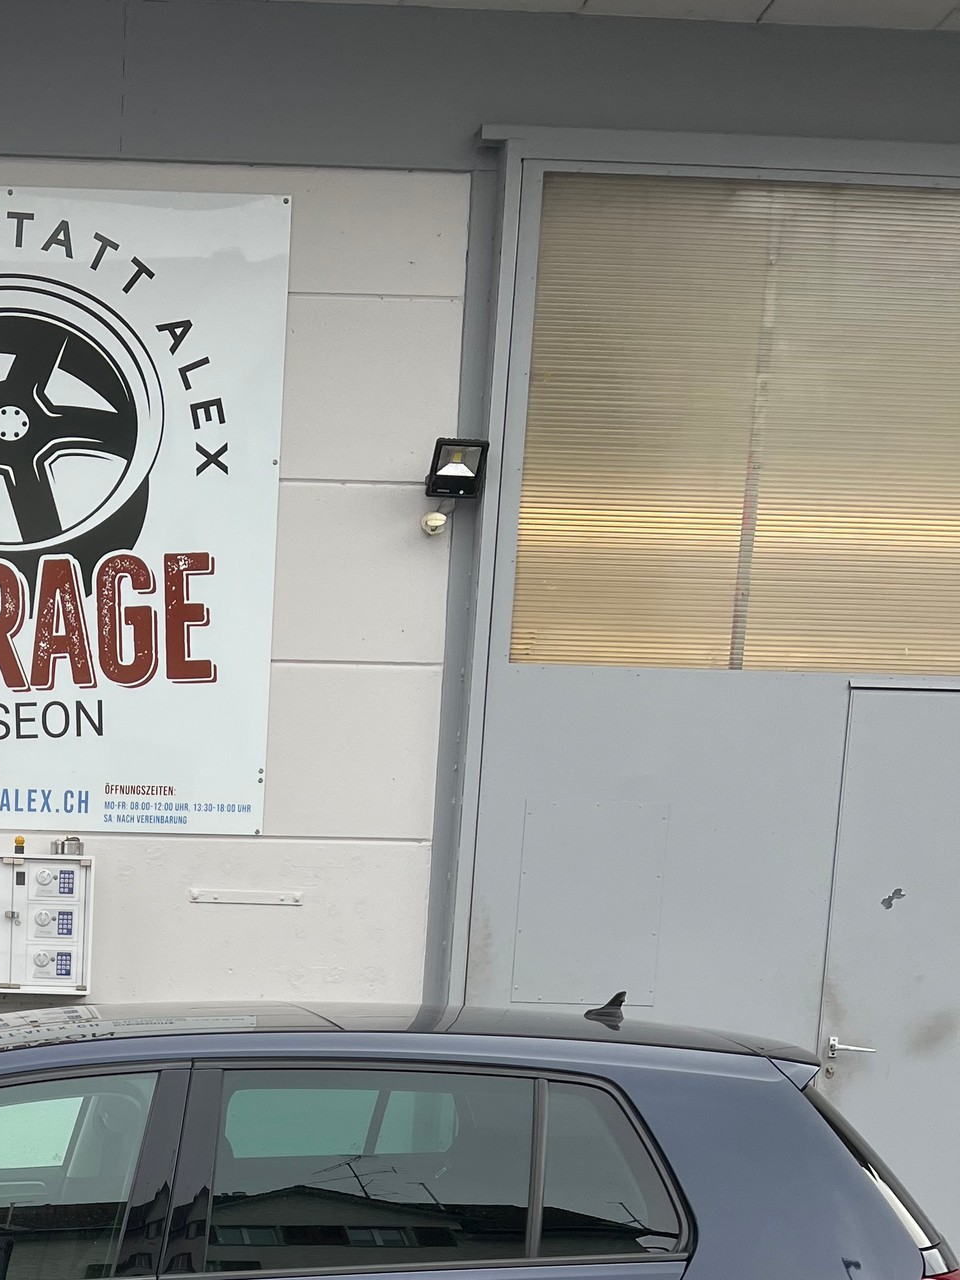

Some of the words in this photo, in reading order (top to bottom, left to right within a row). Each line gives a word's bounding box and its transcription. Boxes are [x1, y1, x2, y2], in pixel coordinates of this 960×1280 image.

[154, 319, 229, 477] ALEX
[104, 782, 177, 796] ÖFFNUNGSZEITEN:
[129, 801, 174, 812] 08:00-12:00
[193, 803, 236, 813] 13:30-18:00
[237, 804, 252, 813] UHR
[116, 814, 135, 824] NACH
[136, 815, 188, 825] VEREINBARUNG
